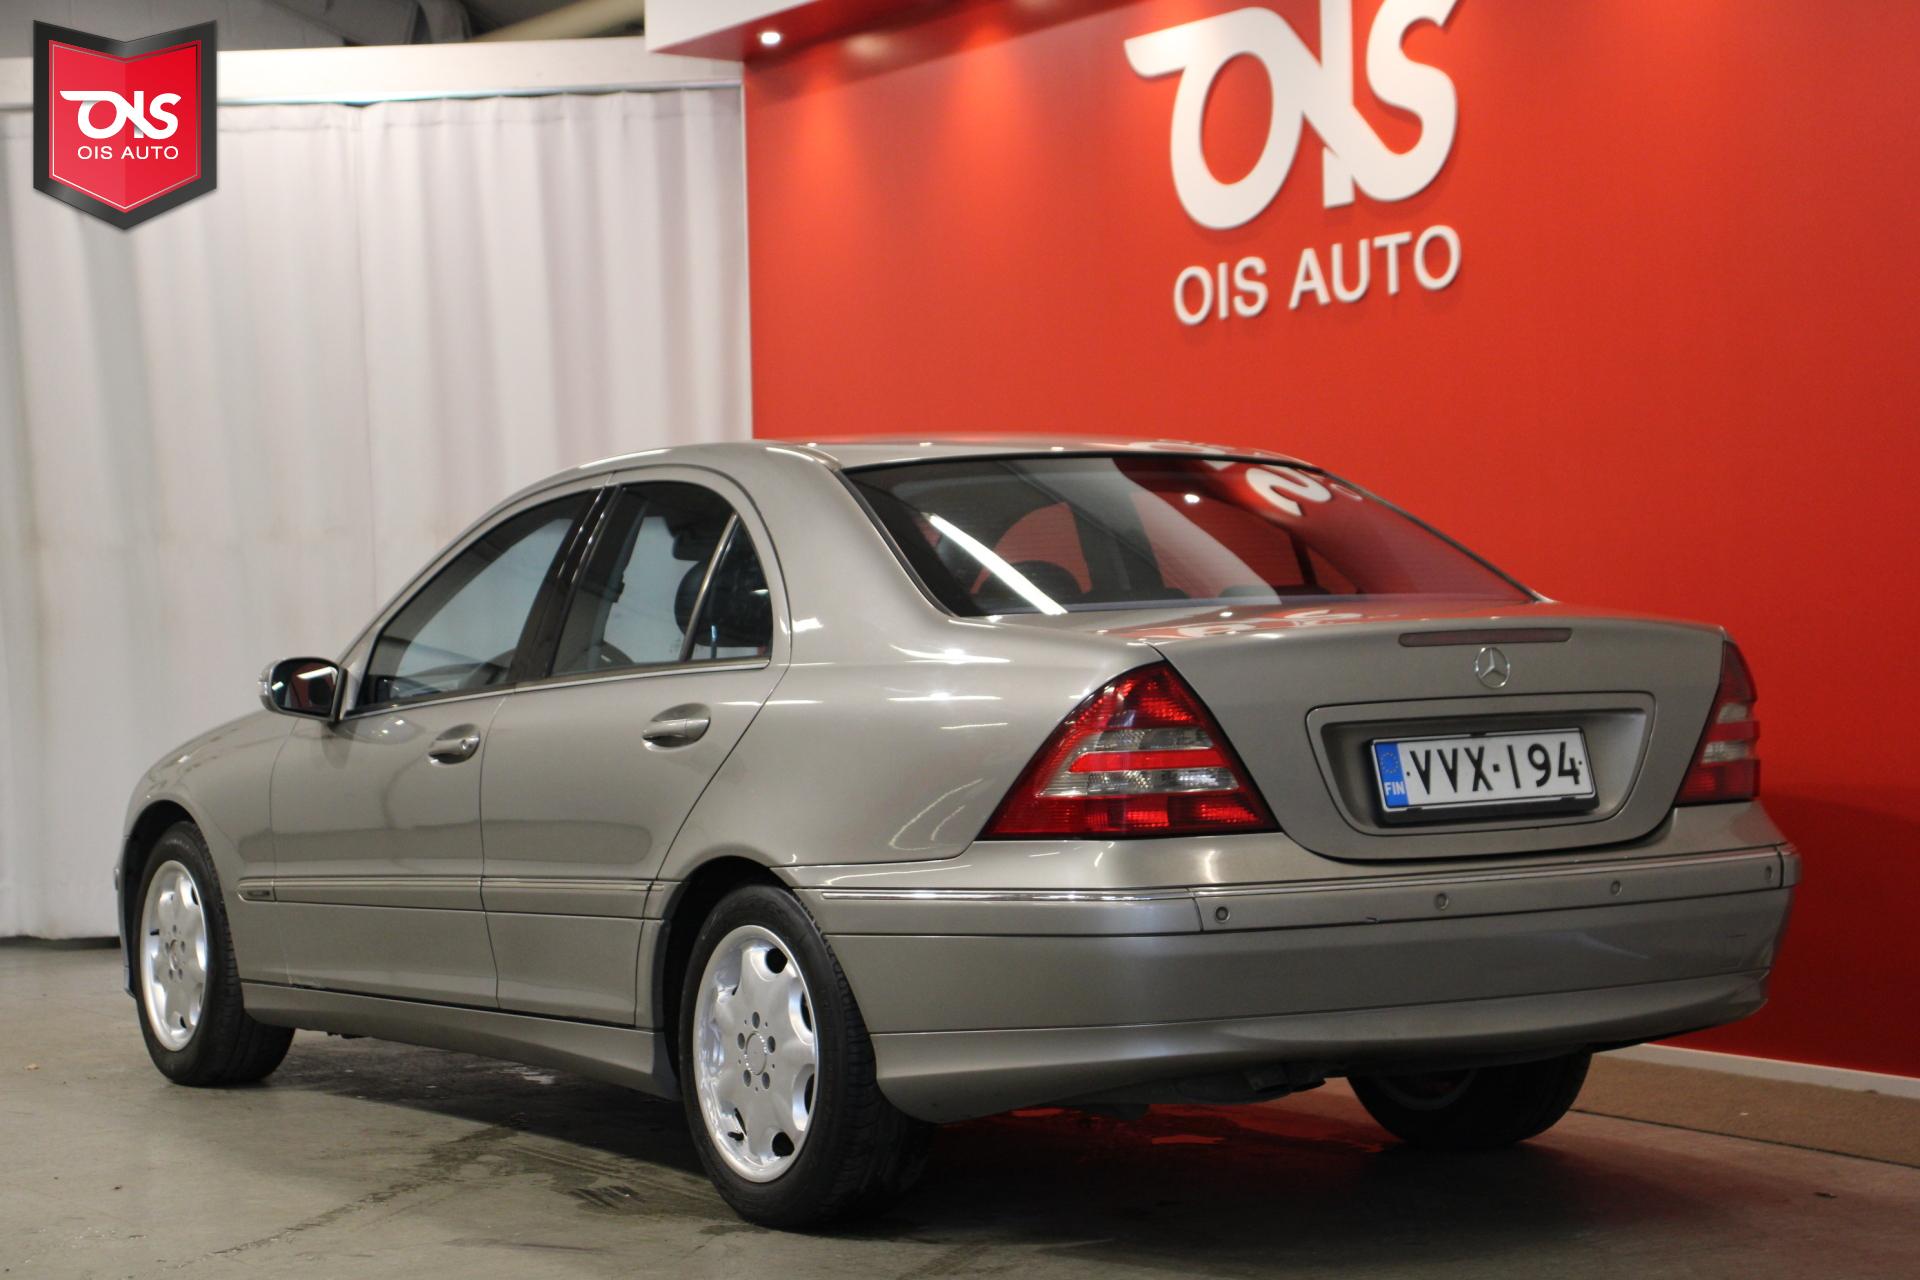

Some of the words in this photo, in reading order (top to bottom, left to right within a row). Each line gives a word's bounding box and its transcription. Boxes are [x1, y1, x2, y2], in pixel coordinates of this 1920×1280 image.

[1124, 0, 1462, 229] OIS
[1173, 255, 1269, 325] OIS
[1289, 224, 1462, 310] AUTO
[1384, 781, 1405, 796] FIN
